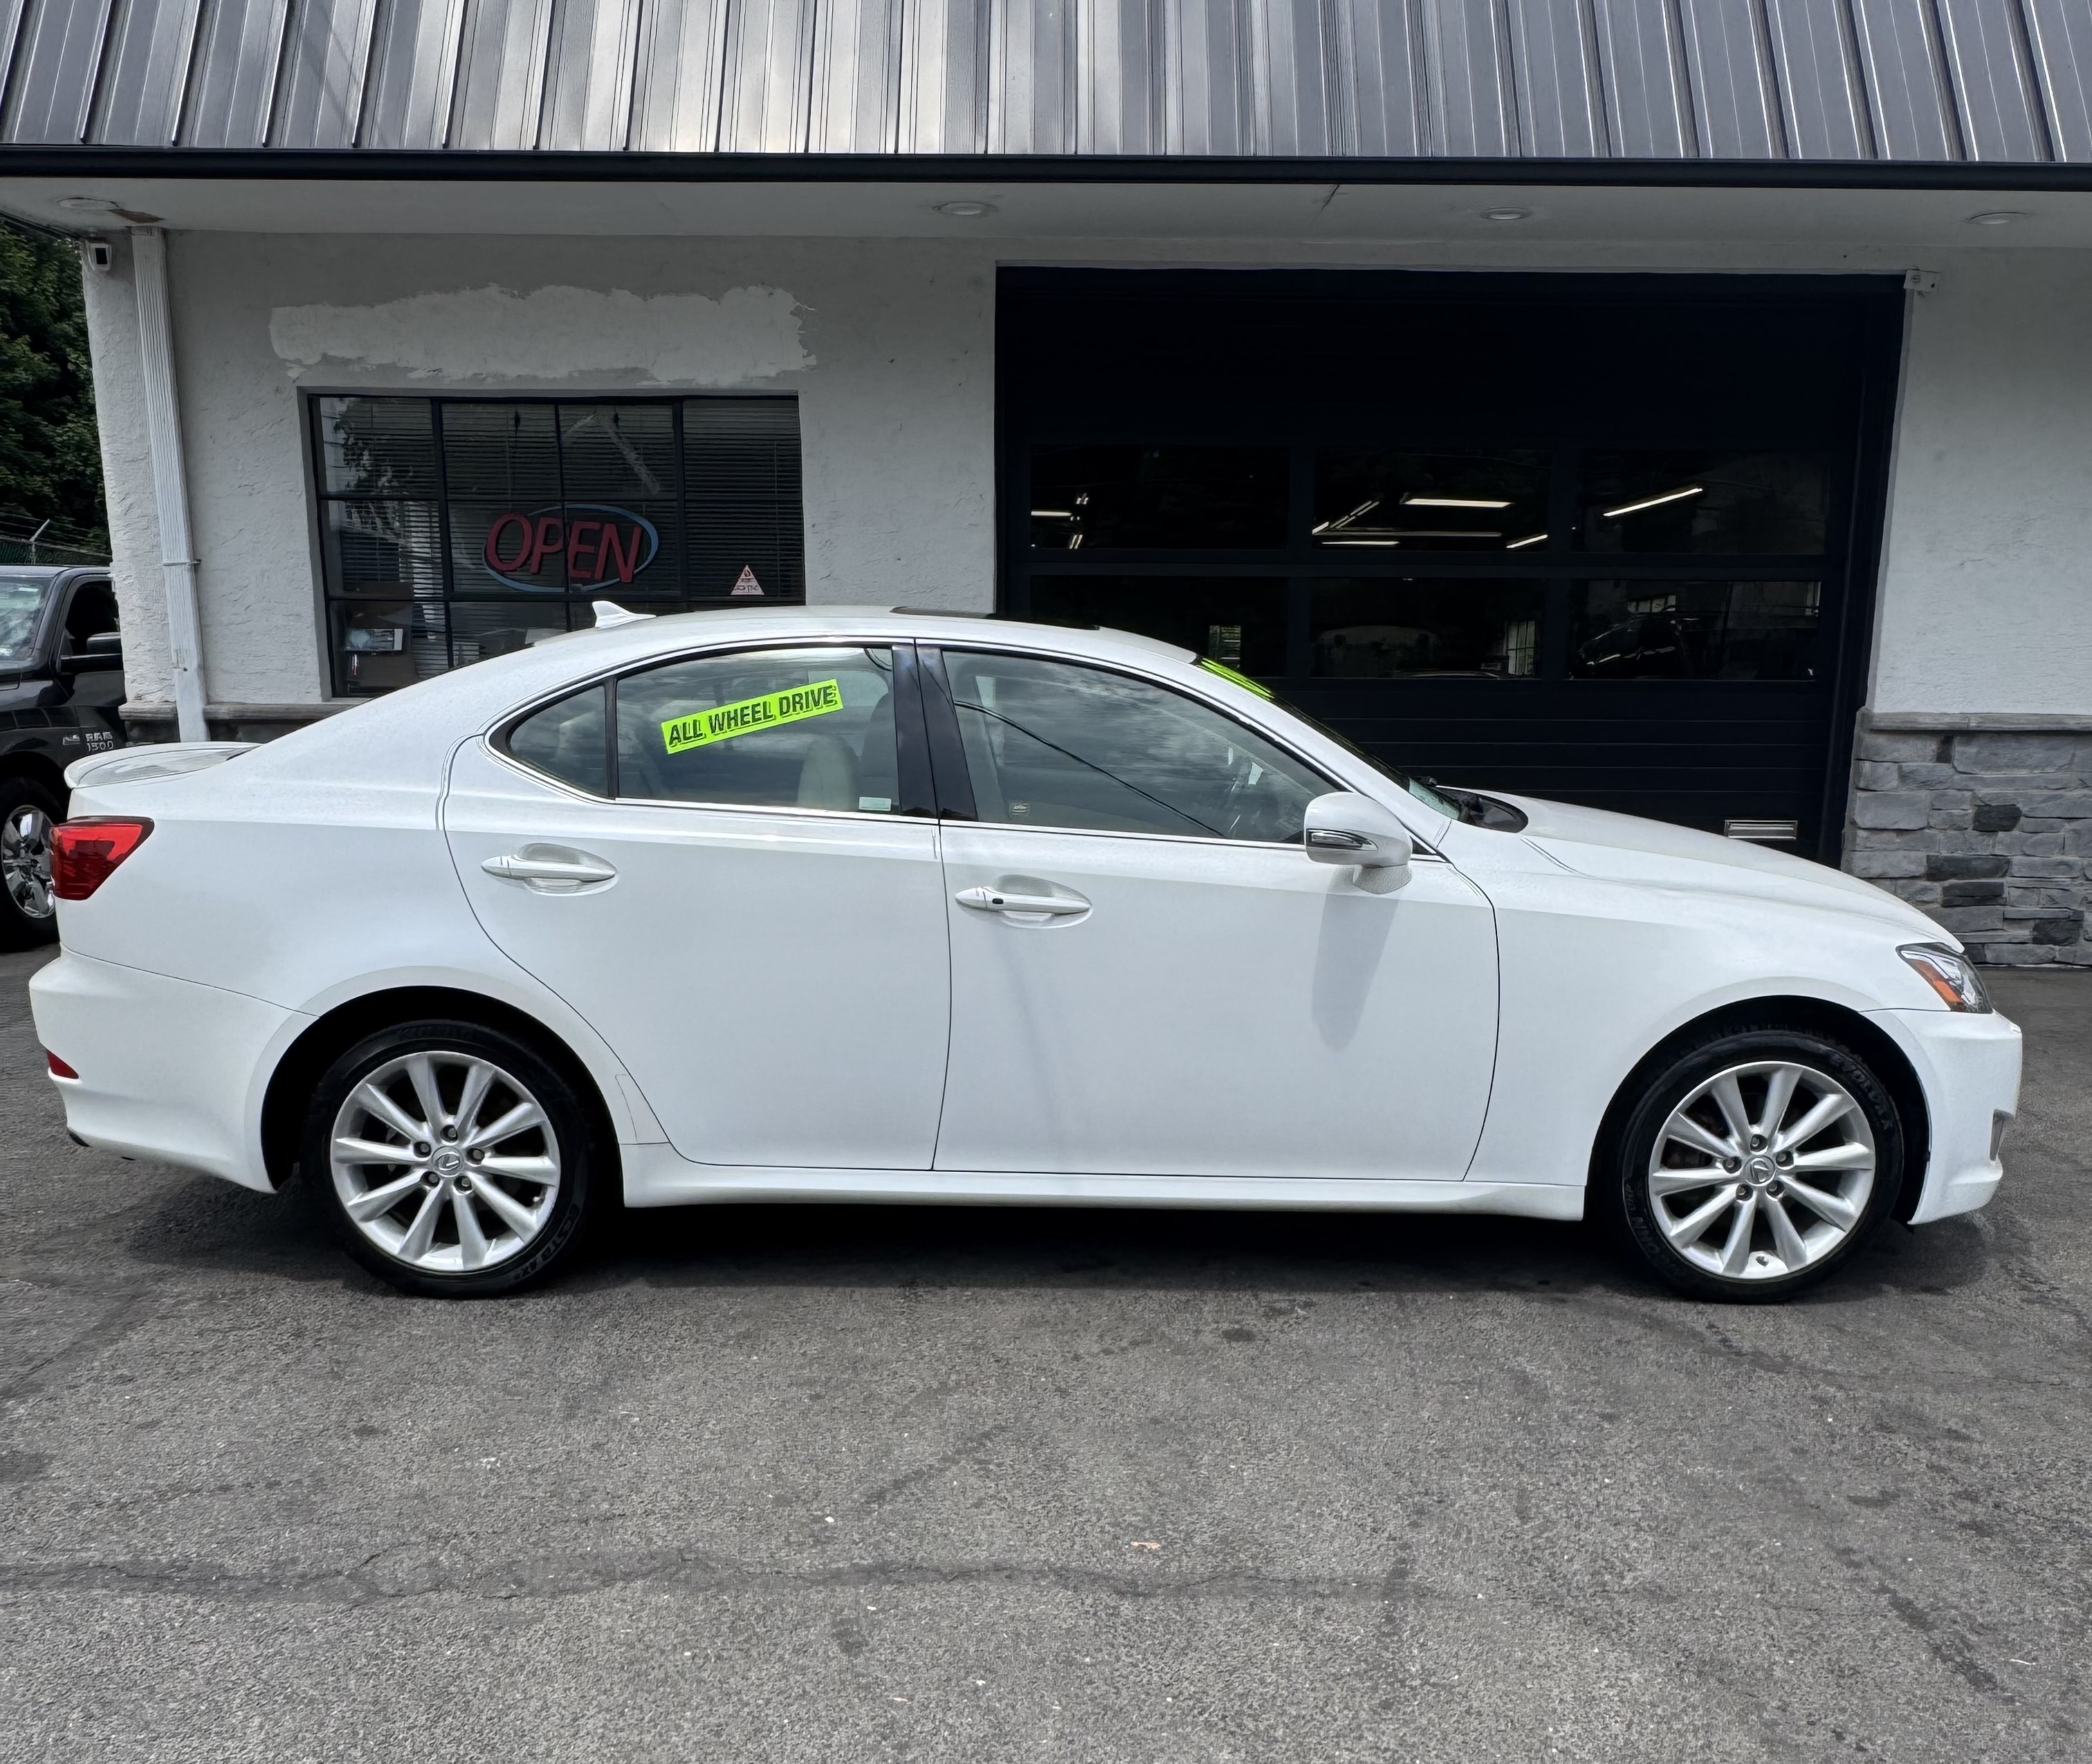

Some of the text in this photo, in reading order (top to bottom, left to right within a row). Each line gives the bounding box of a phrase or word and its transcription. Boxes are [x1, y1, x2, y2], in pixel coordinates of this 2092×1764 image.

[486, 513, 642, 582] OPEN
[86, 741, 114, 752] 1500
[668, 685, 838, 748] ALL WHEEL DRIVE
